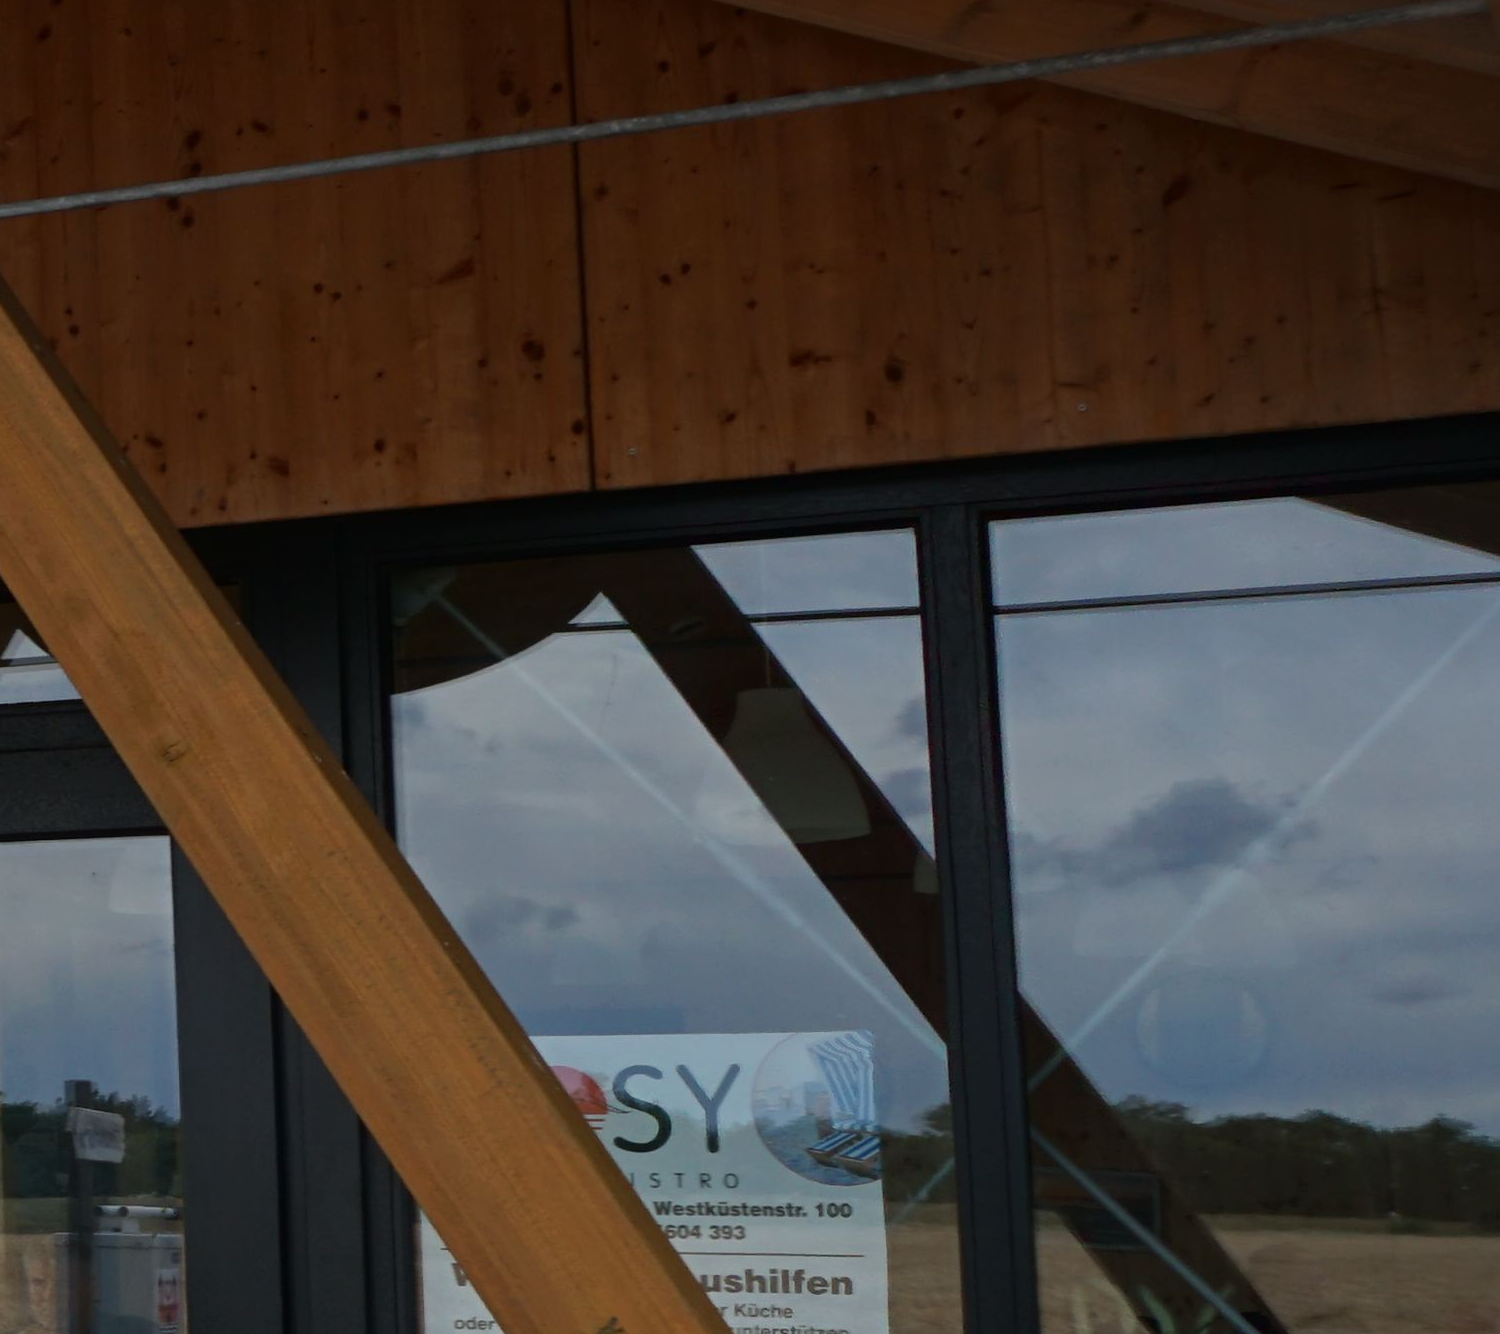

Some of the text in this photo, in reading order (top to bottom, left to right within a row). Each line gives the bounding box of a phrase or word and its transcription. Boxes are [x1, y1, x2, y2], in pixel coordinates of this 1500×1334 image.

[653, 1201, 853, 1218] Westküstenstr. 100
[709, 1224, 746, 1240] 393
[700, 1269, 854, 1296] ushilfen
[734, 1303, 794, 1319] Küche
[454, 1317, 496, 1331] oder
